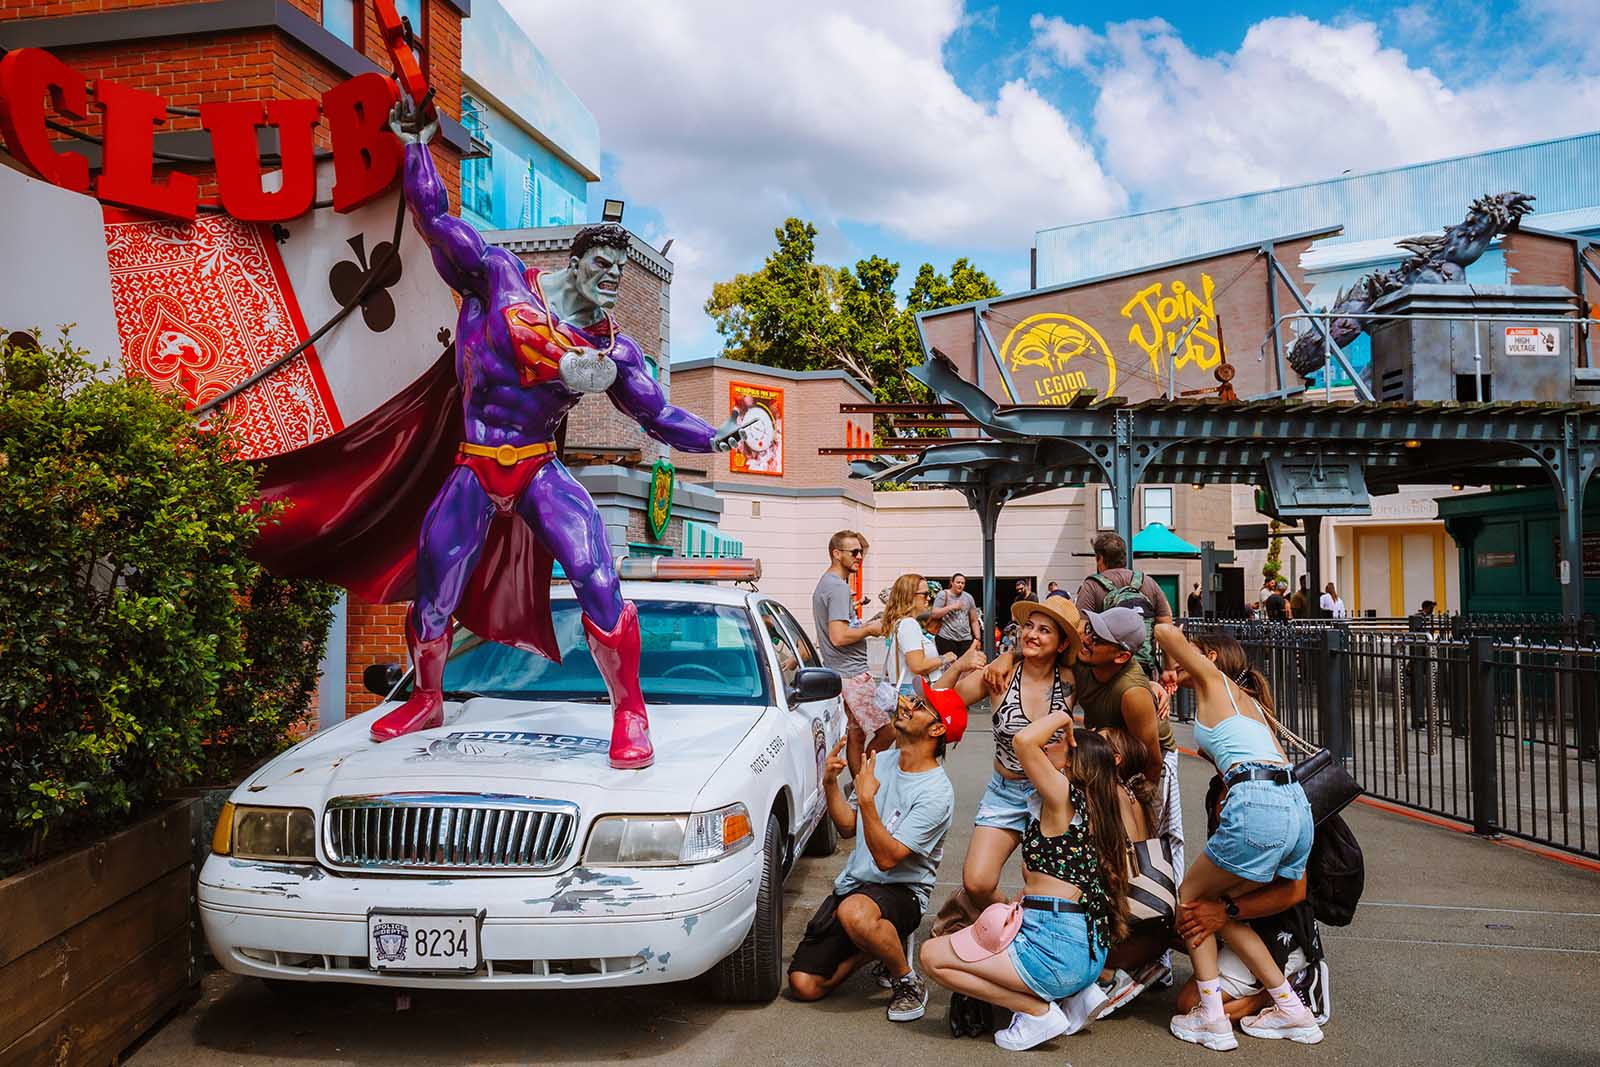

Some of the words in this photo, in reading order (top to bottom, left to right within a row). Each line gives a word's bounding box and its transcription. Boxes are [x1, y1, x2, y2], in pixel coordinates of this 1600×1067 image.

[0, 47, 404, 222] CLUB
[1508, 344, 1536, 352] VOLTAGE
[1034, 370, 1088, 397] LEGION
[460, 732, 600, 747] POLICE
[415, 929, 468, 957] 8234
